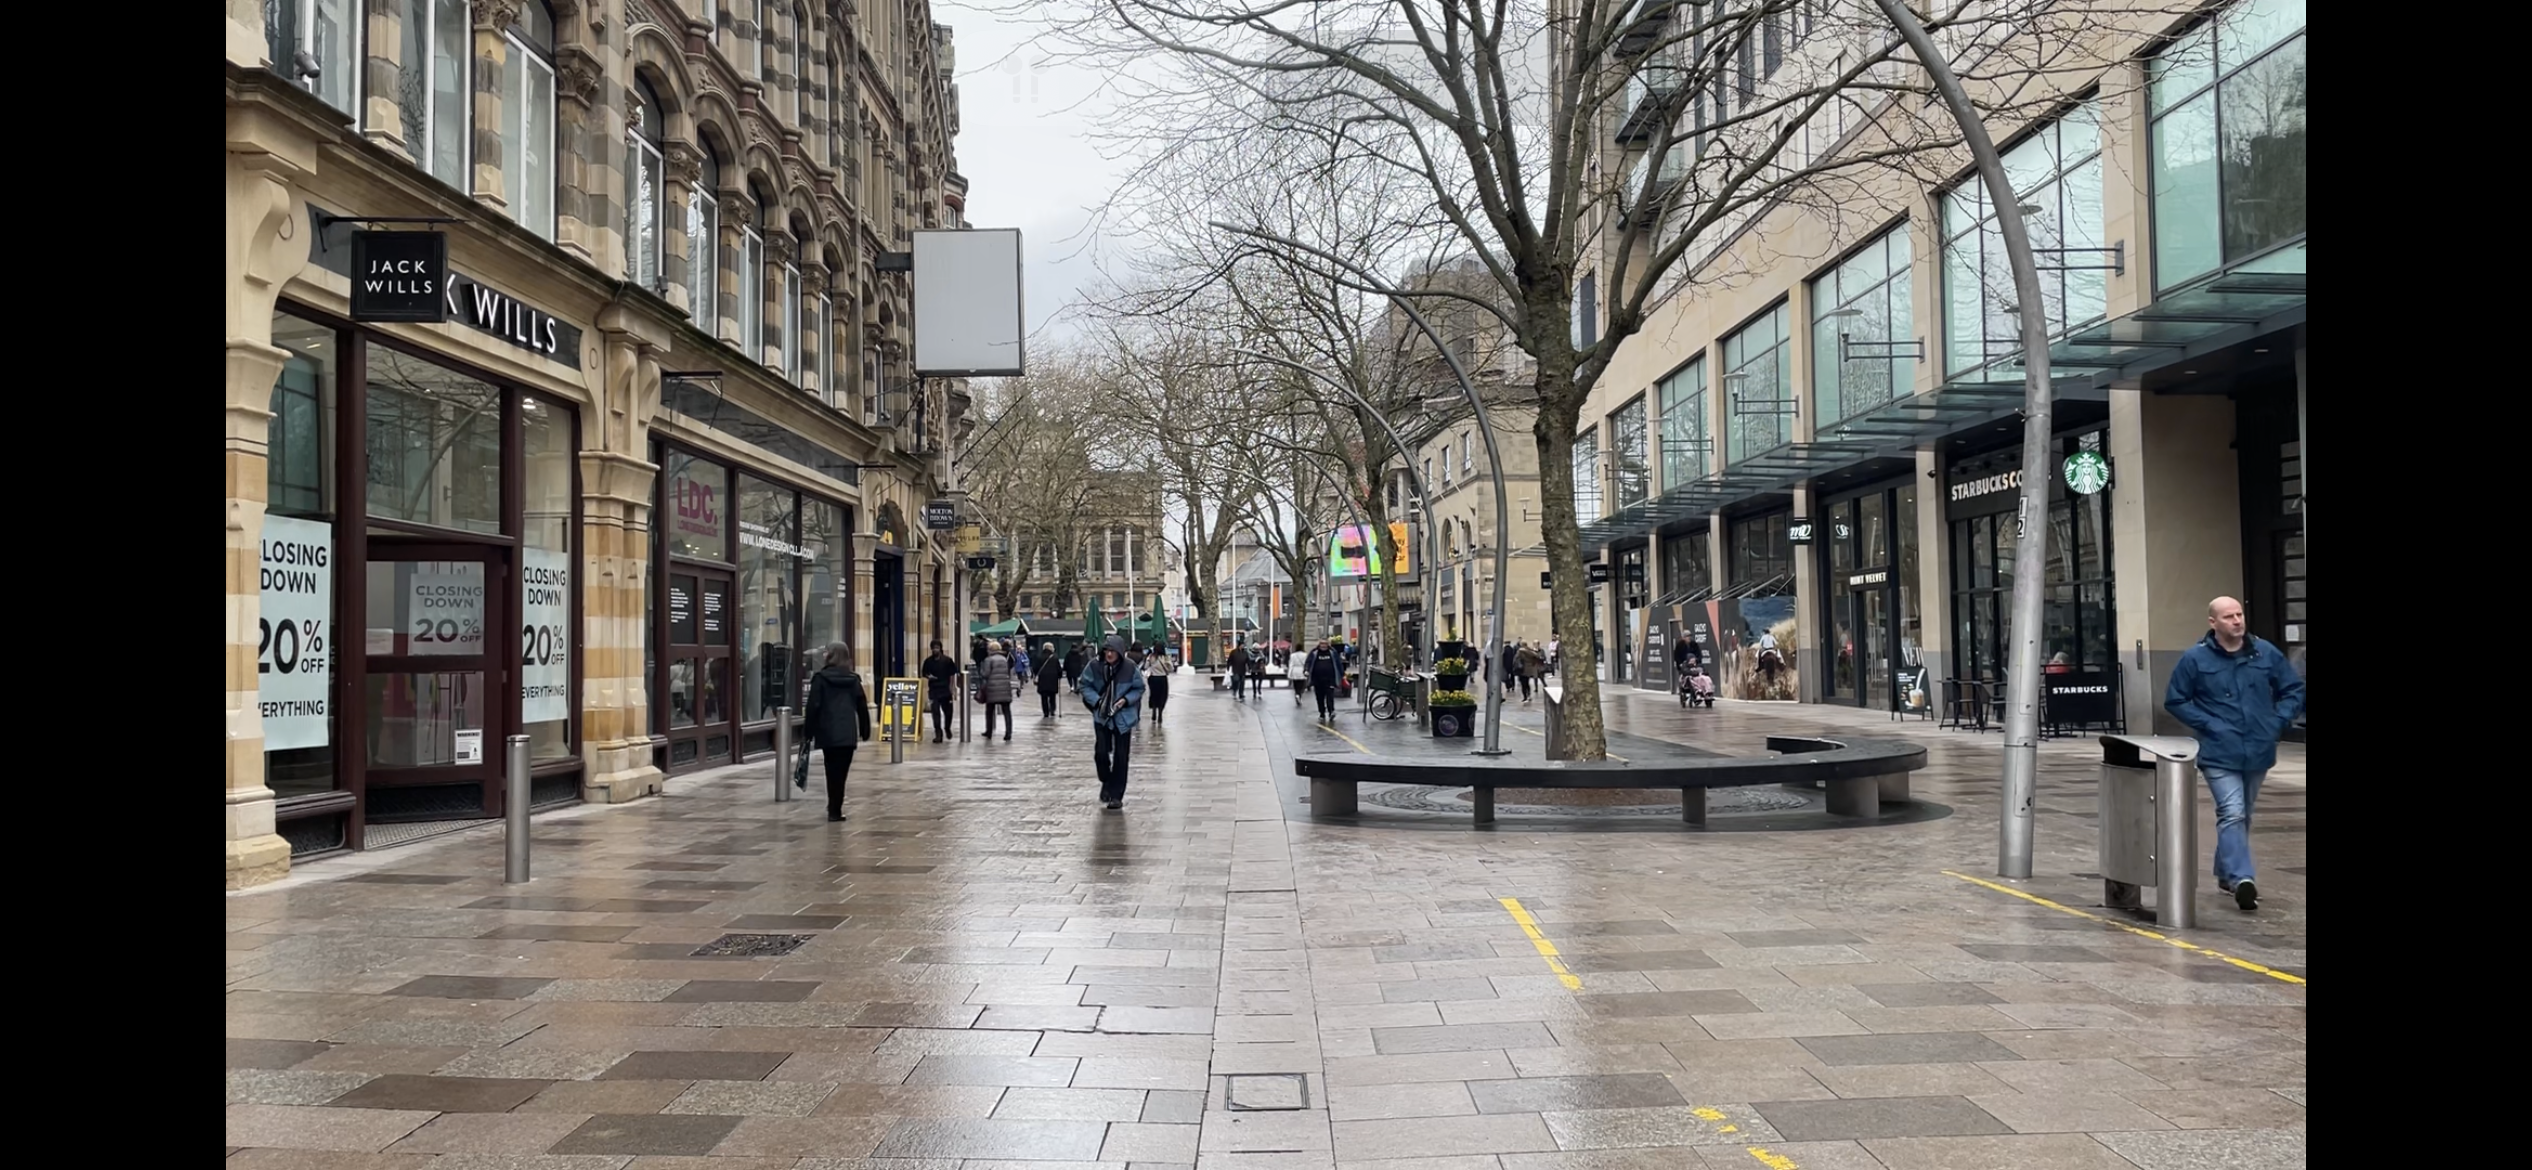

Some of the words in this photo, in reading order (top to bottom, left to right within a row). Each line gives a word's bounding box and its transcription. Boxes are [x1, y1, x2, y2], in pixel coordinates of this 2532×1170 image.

[371, 260, 426, 274] JACK
[365, 280, 432, 294] WILLS
[473, 283, 556, 353] WILLS
[1952, 473, 2008, 501] STARBUCKS
[260, 539, 327, 568] LOSING
[261, 568, 316, 594] DOWN
[523, 566, 566, 586] CLOSING
[416, 585, 483, 596] CLOSING
[528, 588, 561, 606] DOWN
[424, 597, 474, 608] DOWN
[413, 618, 480, 643] 20%
[522, 624, 564, 666] 20%
[301, 658, 324, 673] OFF
[551, 653, 565, 665] OFF
[521, 684, 565, 699] EVERYTHING
[887, 682, 917, 691] yellow
[2052, 685, 2108, 694] STARBUCKS
[258, 700, 324, 718] ERYTHING
